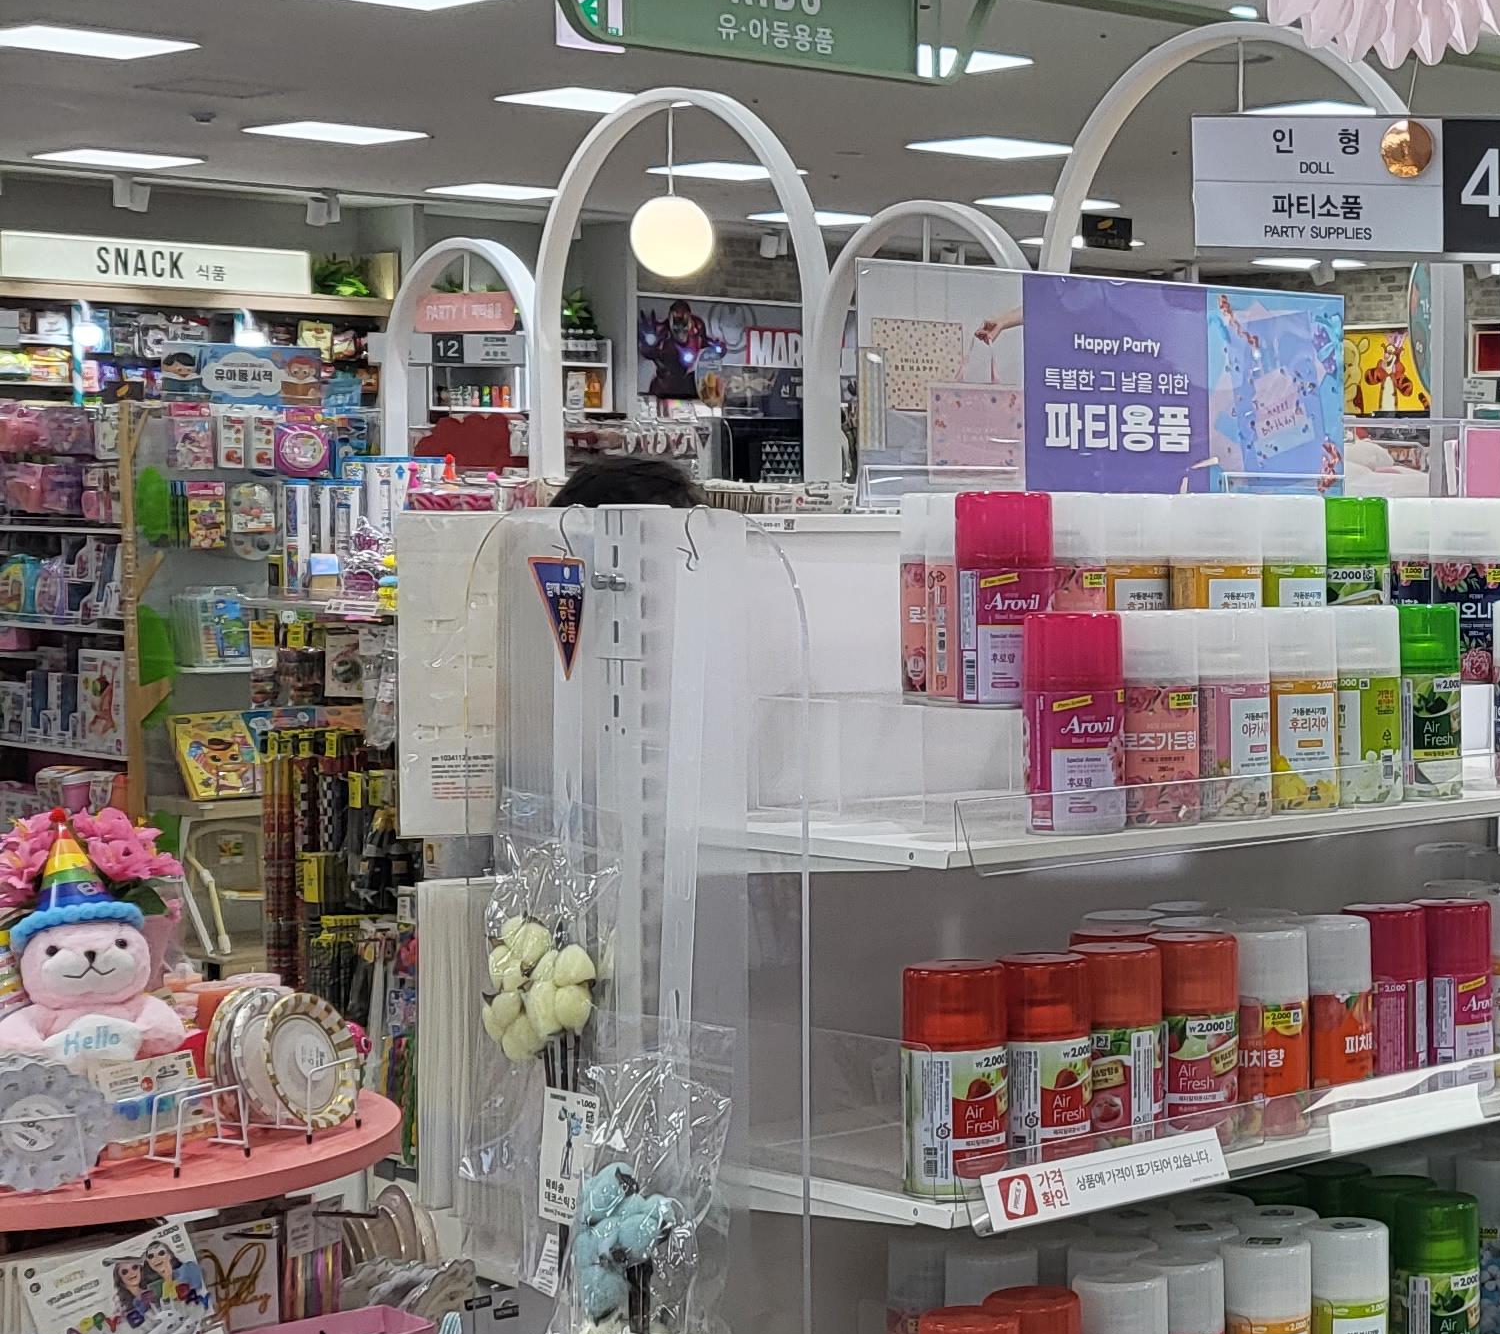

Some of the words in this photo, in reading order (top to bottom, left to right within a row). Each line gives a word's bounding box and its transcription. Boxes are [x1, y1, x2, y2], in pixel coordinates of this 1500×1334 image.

[716, 12, 835, 56] 유·아동용품
[1299, 160, 1335, 176] DOLL
[1271, 192, 1363, 222] 파티소품
[1263, 223, 1307, 241] PARTY
[1310, 223, 1373, 242] SUPPLIES
[96, 246, 184, 280] SNACK
[195, 262, 227, 283] 식품
[436, 338, 461, 359] 12
[1073, 332, 1120, 354] Happy
[1122, 334, 1161, 358] Party
[1043, 367, 1096, 392] 특별한
[1098, 369, 1117, 392] 그
[1120, 371, 1153, 395] 날을
[1157, 372, 1190, 396] 위한
[1043, 402, 1192, 454] 파티용품
[984, 592, 1041, 612] Arovil
[1060, 715, 1115, 735] Arovil
[1289, 716, 1329, 733] 후리지아
[1423, 720, 1441, 734] Air
[1124, 730, 1197, 751] 로즈가든향
[1423, 731, 1455, 747] Fresh
[63, 1028, 122, 1055] Hello
[1178, 1063, 1197, 1078] Air
[1178, 1076, 1216, 1091] Fresh
[1052, 1093, 1072, 1109] Air
[964, 1105, 985, 1120] Air
[1053, 1107, 1086, 1124] Fresh
[965, 1119, 1000, 1134] Fresh
[1037, 1171, 1066, 1188] 가격
[1075, 1172, 1106, 1192] 상품에
[1106, 1165, 1135, 1185] 가격이
[1136, 1158, 1173, 1179] 표기되어
[1173, 1149, 1214, 1170] 있습니다.
[1040, 1190, 1071, 1209] 확인
[1439, 1317, 1459, 1332] Air
